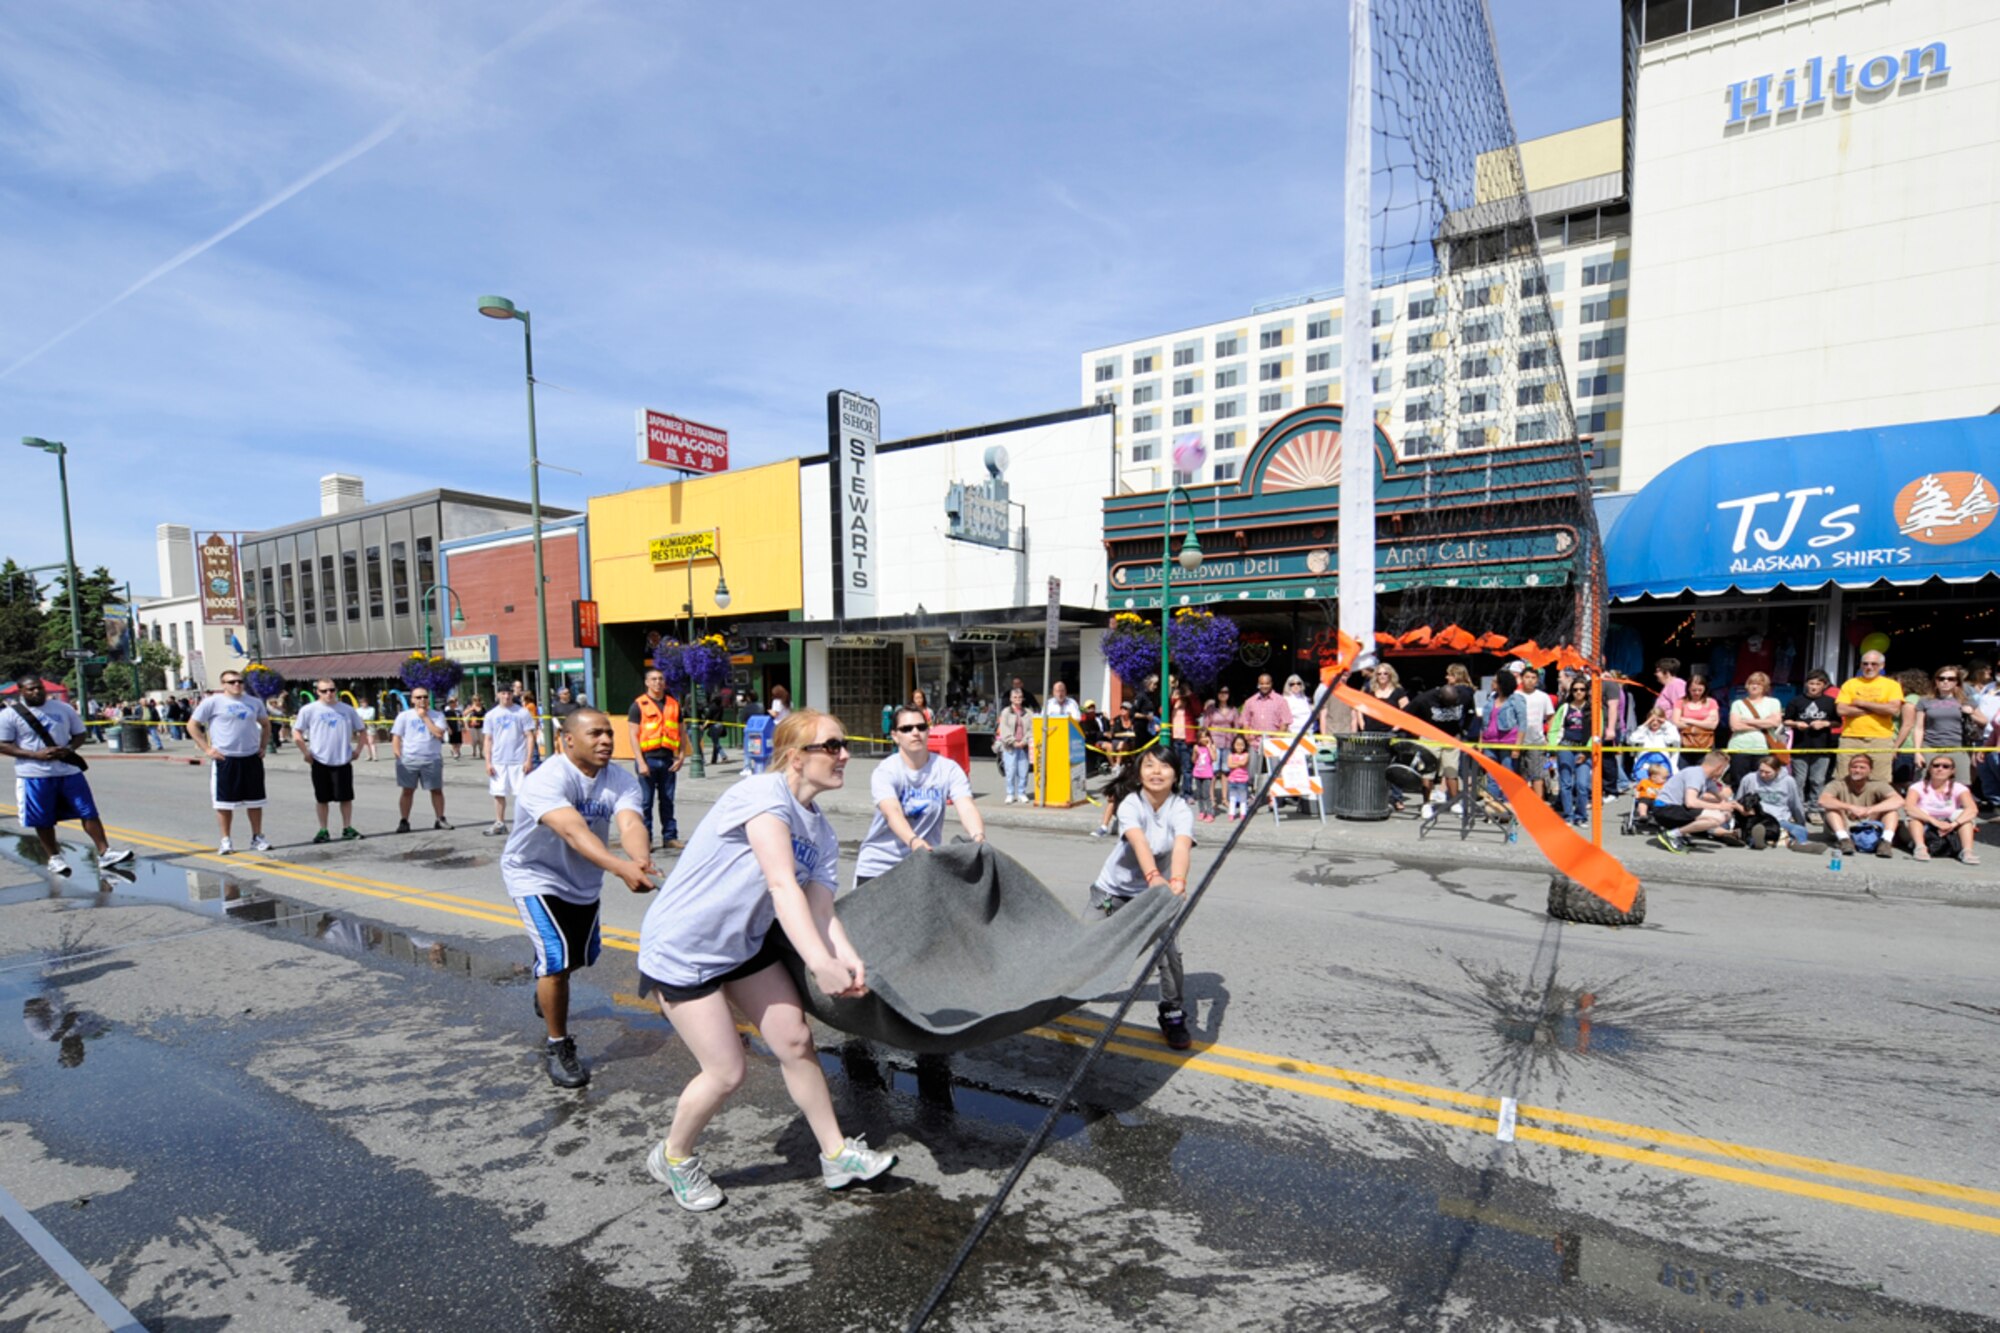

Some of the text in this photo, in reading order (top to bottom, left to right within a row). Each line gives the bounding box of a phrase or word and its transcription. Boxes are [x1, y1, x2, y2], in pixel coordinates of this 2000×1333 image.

[1726, 42, 1951, 124] Hilton
[648, 414, 726, 444] JAPANESE RESTAURANT
[651, 428, 726, 458] KUMAGORO
[848, 437, 869, 588] STEWARTS
[1717, 486, 1860, 554] TJ's
[203, 545, 229, 556] ONCE
[651, 544, 713, 561] RESTAURANT
[659, 534, 704, 548] KUMAGORO
[1244, 556, 1280, 575] Deli
[1385, 542, 1428, 564] And
[1439, 540, 1488, 560] Cafe
[1730, 547, 1911, 573] ALASKAN SHIRTS
[206, 597, 237, 609] MOOSE
[958, 632, 1008, 641] JADE
